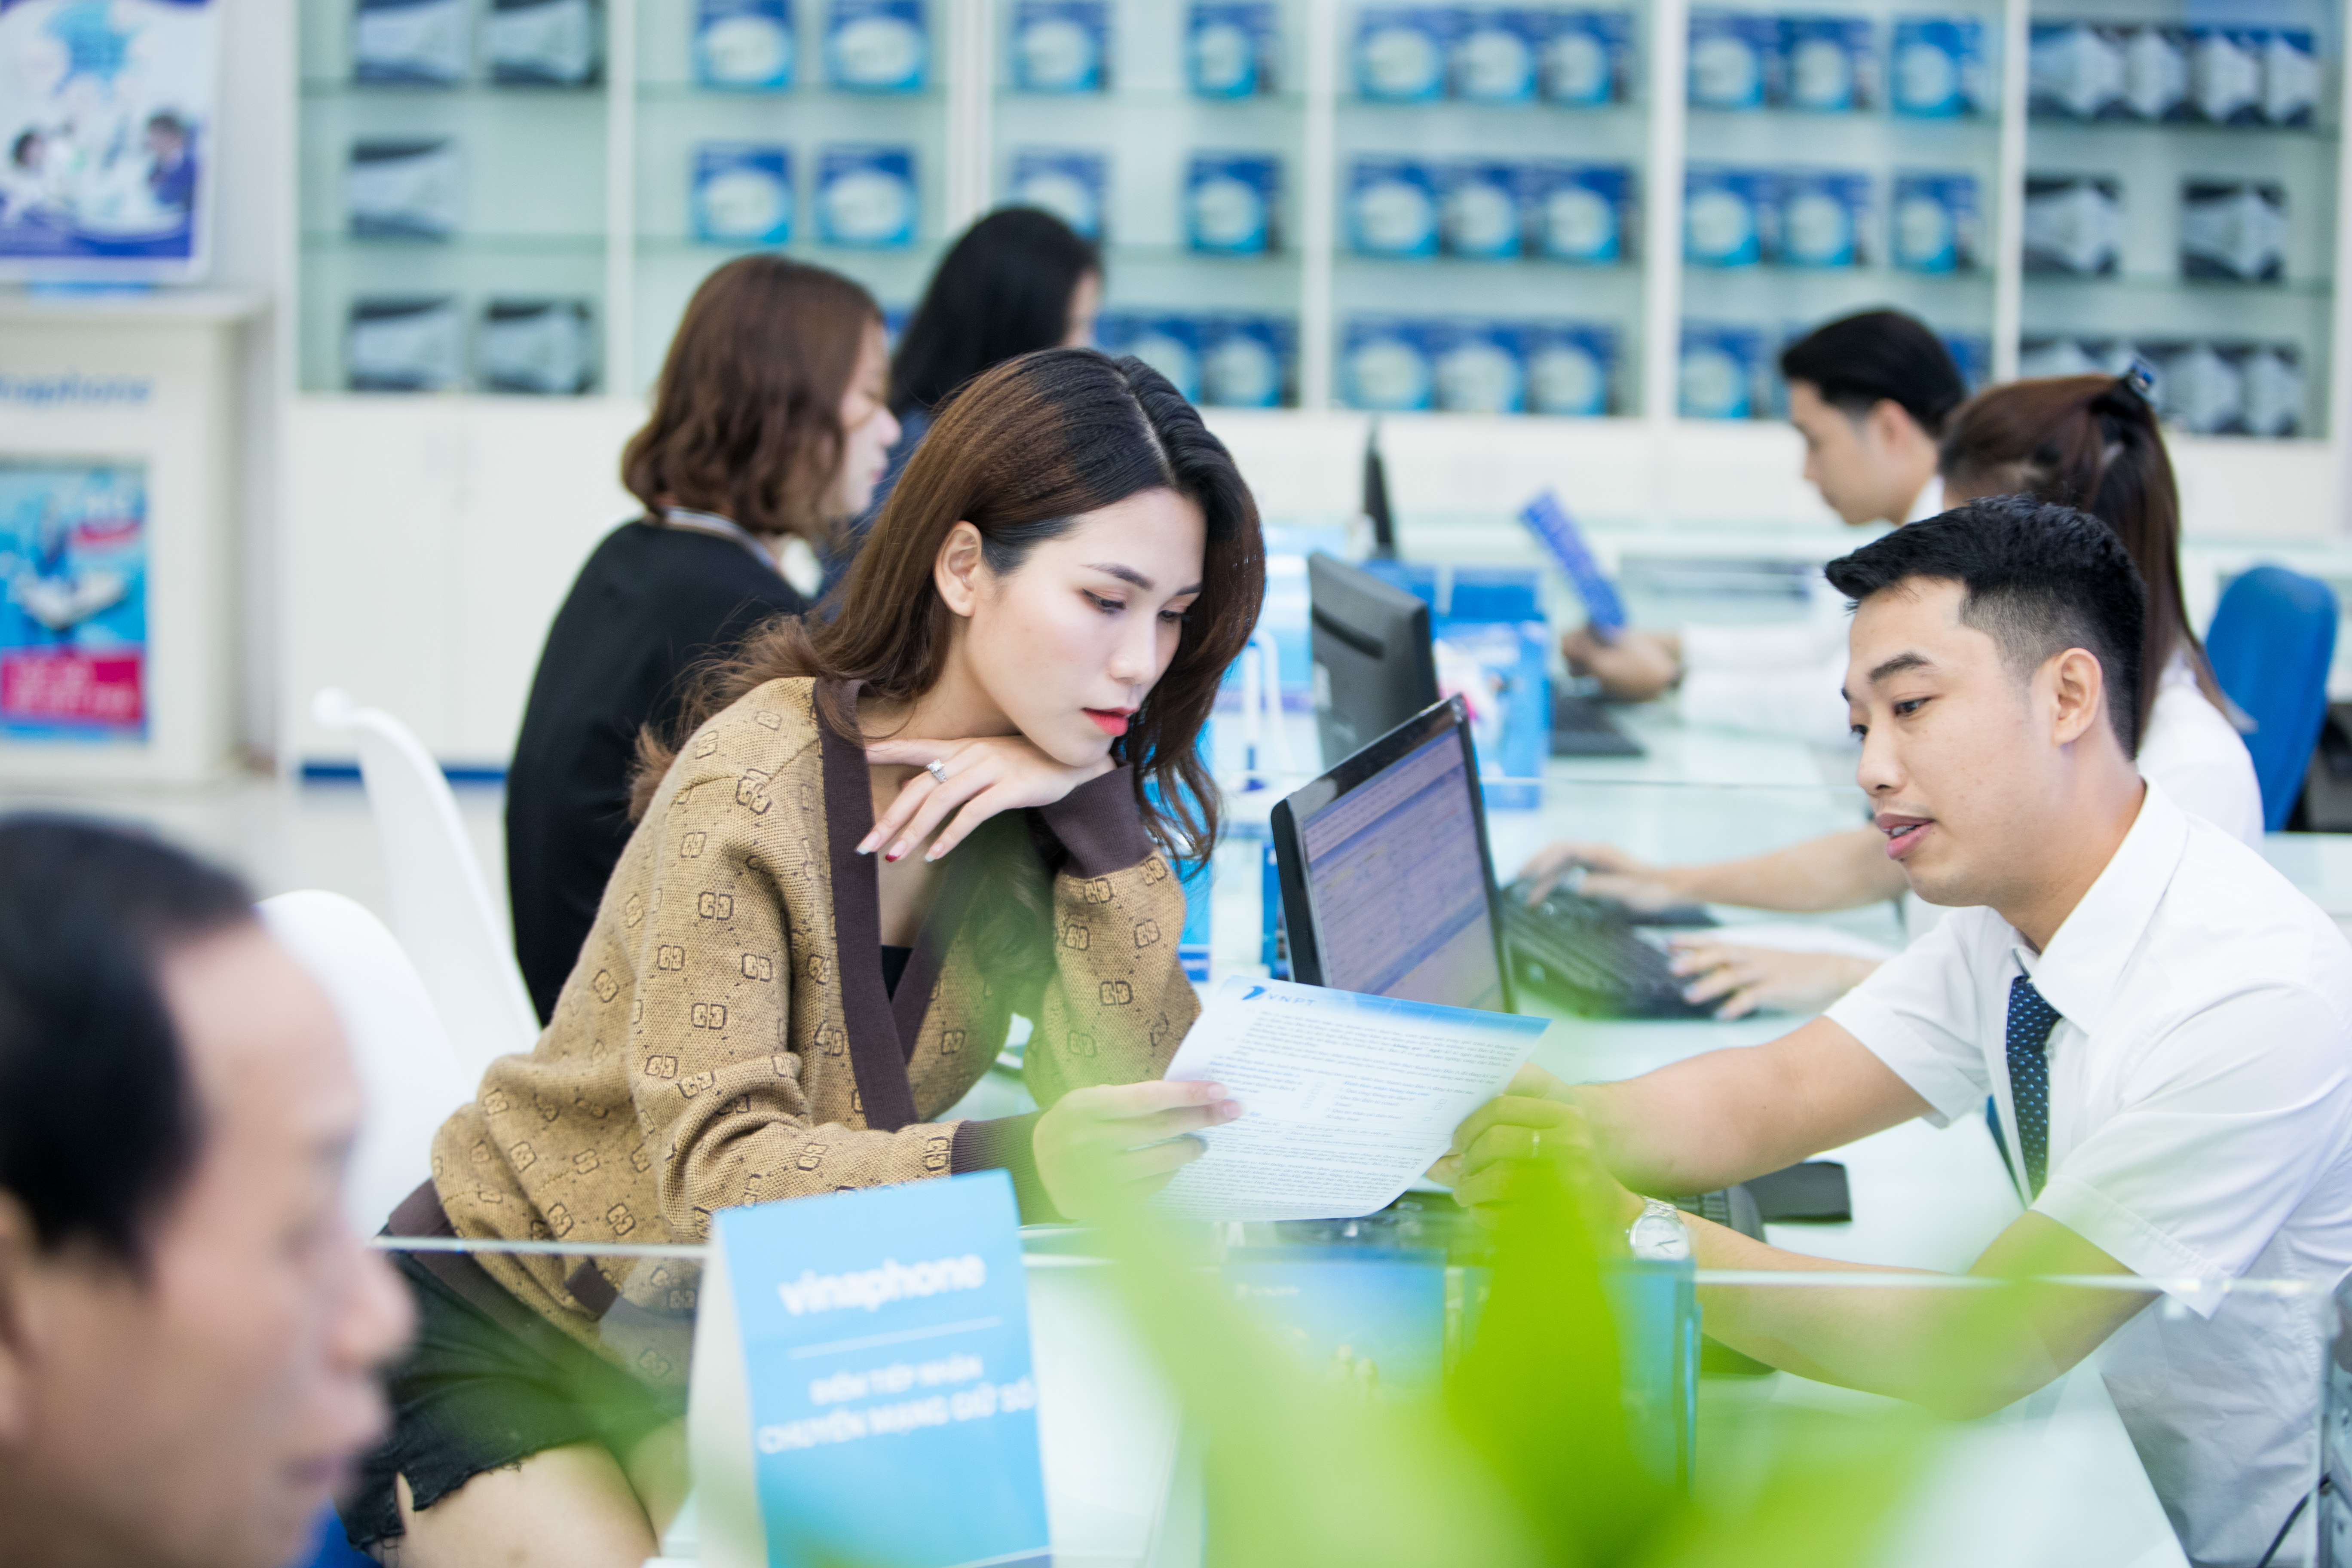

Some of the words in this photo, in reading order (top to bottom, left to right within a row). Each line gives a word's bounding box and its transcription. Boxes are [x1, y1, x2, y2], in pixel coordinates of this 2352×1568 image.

[1268, 993, 1317, 1006] VNPT
[778, 1254, 986, 1314] vinaphone
[757, 1407, 867, 1454] CHUYỂN
